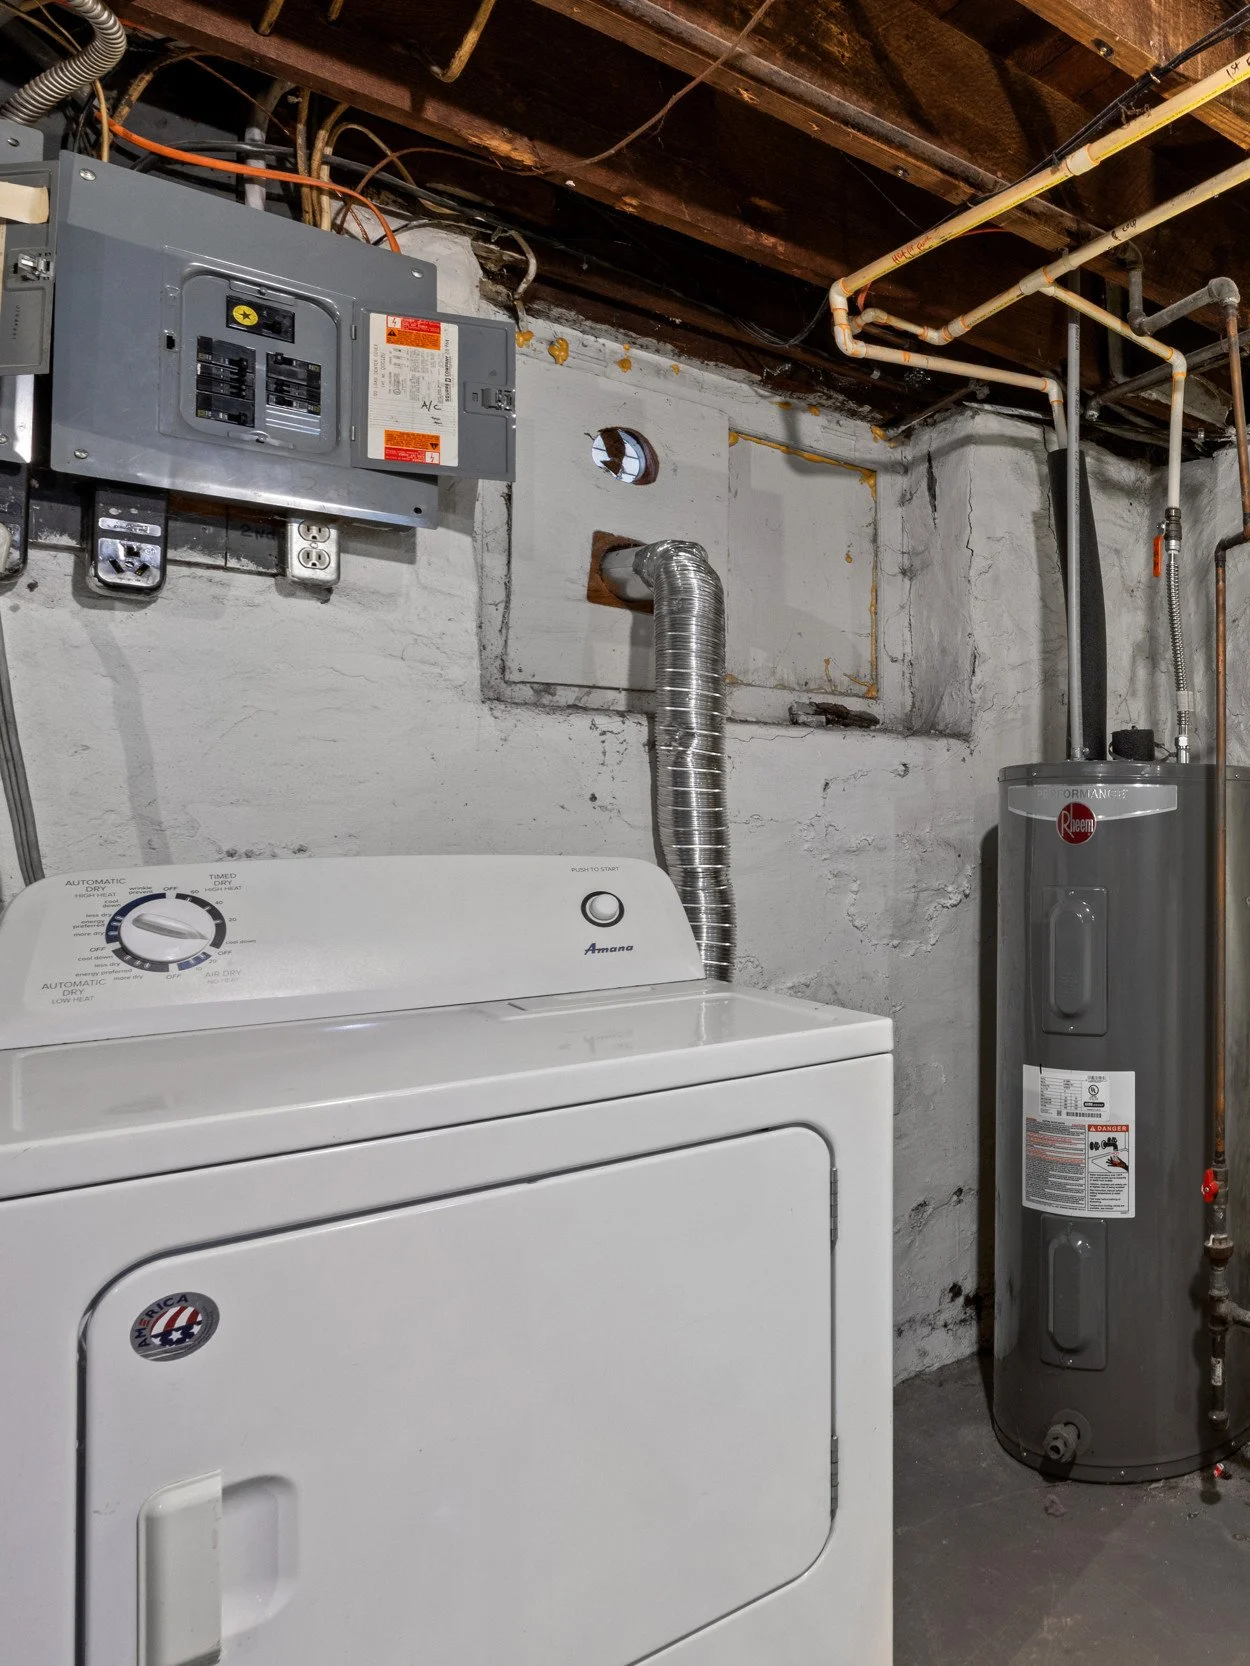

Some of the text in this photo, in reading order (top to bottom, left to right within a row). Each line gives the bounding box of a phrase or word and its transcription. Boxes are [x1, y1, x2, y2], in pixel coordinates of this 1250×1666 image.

[421, 400, 442, 412] A/C
[1061, 804, 1094, 838] Rheem
[65, 878, 127, 887] AUTOMATIC
[85, 885, 107, 893] DRY
[584, 943, 634, 955] Amana
[222, 969, 242, 977] DRY
[41, 979, 107, 990] AUTOMATIC
[62, 988, 85, 997] DRY
[134, 1294, 189, 1348] AMERICA
